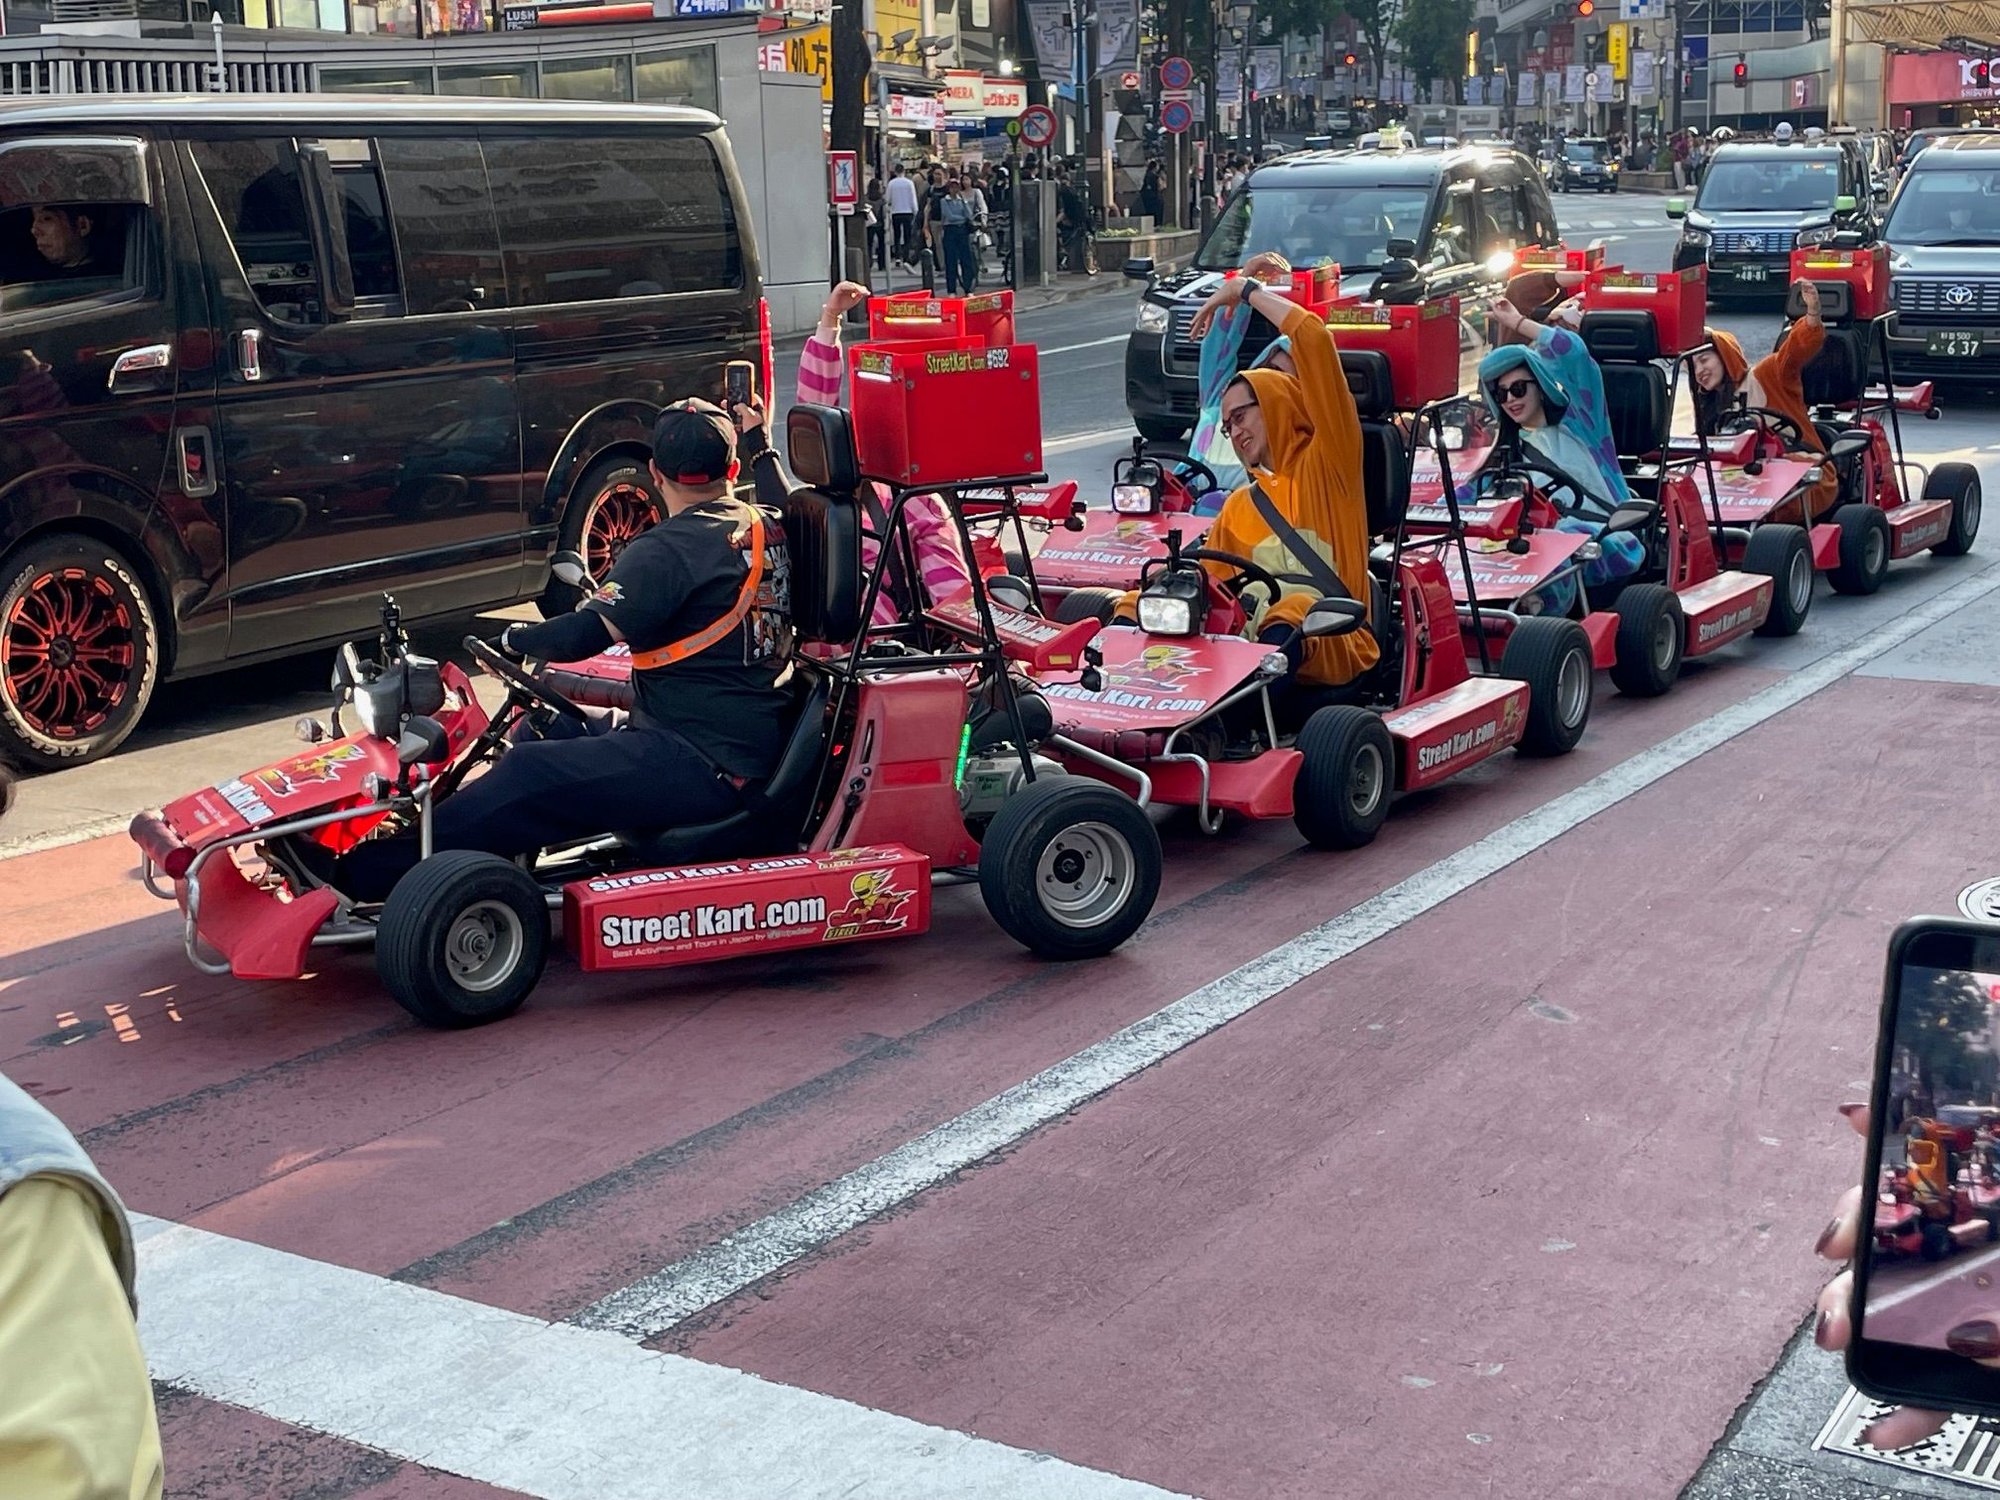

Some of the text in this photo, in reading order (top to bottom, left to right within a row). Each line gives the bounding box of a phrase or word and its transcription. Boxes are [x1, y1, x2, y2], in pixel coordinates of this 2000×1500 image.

[506, 10, 535, 21] LUSH
[987, 348, 1010, 369] #692
[588, 871, 681, 892] Street
[602, 910, 692, 948] Street
[612, 949, 634, 959] Best
[676, 942, 693, 951] and
[694, 939, 718, 951] Tours
[729, 935, 753, 946] Japan
